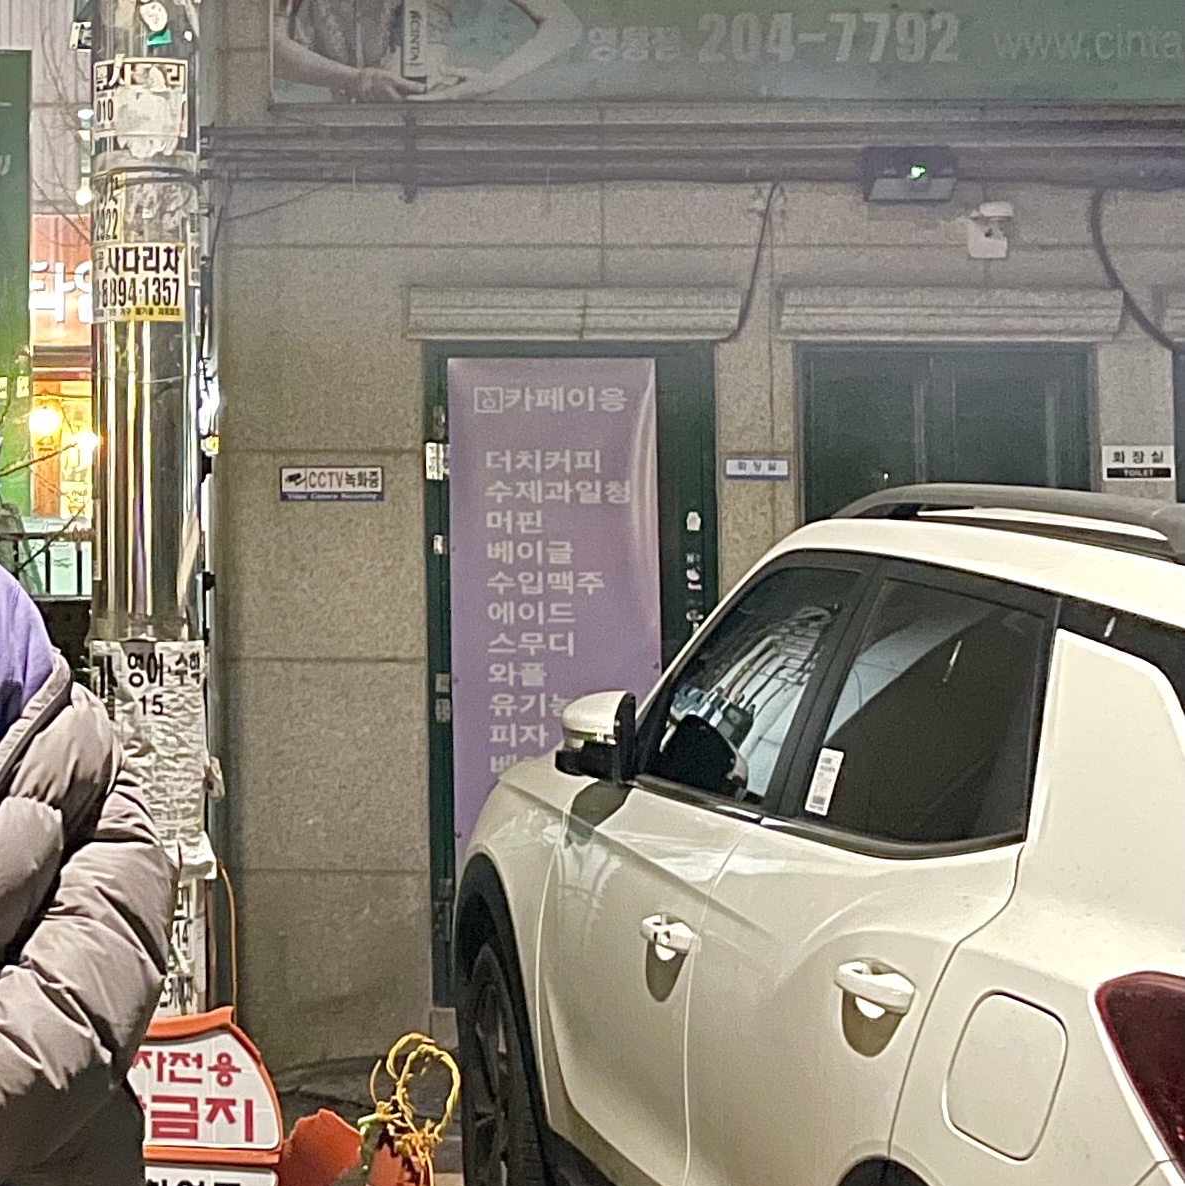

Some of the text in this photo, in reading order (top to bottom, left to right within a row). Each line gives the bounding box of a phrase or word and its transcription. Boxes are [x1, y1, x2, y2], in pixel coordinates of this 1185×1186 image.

[698, 11, 961, 64] 204-7792
[105, 245, 180, 276] 사다리차
[503, 386, 628, 412] 카페이응
[485, 449, 602, 474] 더치커피
[485, 480, 631, 504] 수제과일청
[486, 510, 543, 534] 머핀
[486, 540, 574, 565] 베이글
[486, 571, 605, 595] 수입맥주
[487, 601, 576, 625] 에이드
[487, 632, 575, 656] 스무디
[488, 662, 547, 687] 와플
[490, 723, 549, 749] 피자
[139, 1095, 254, 1143] 금지
